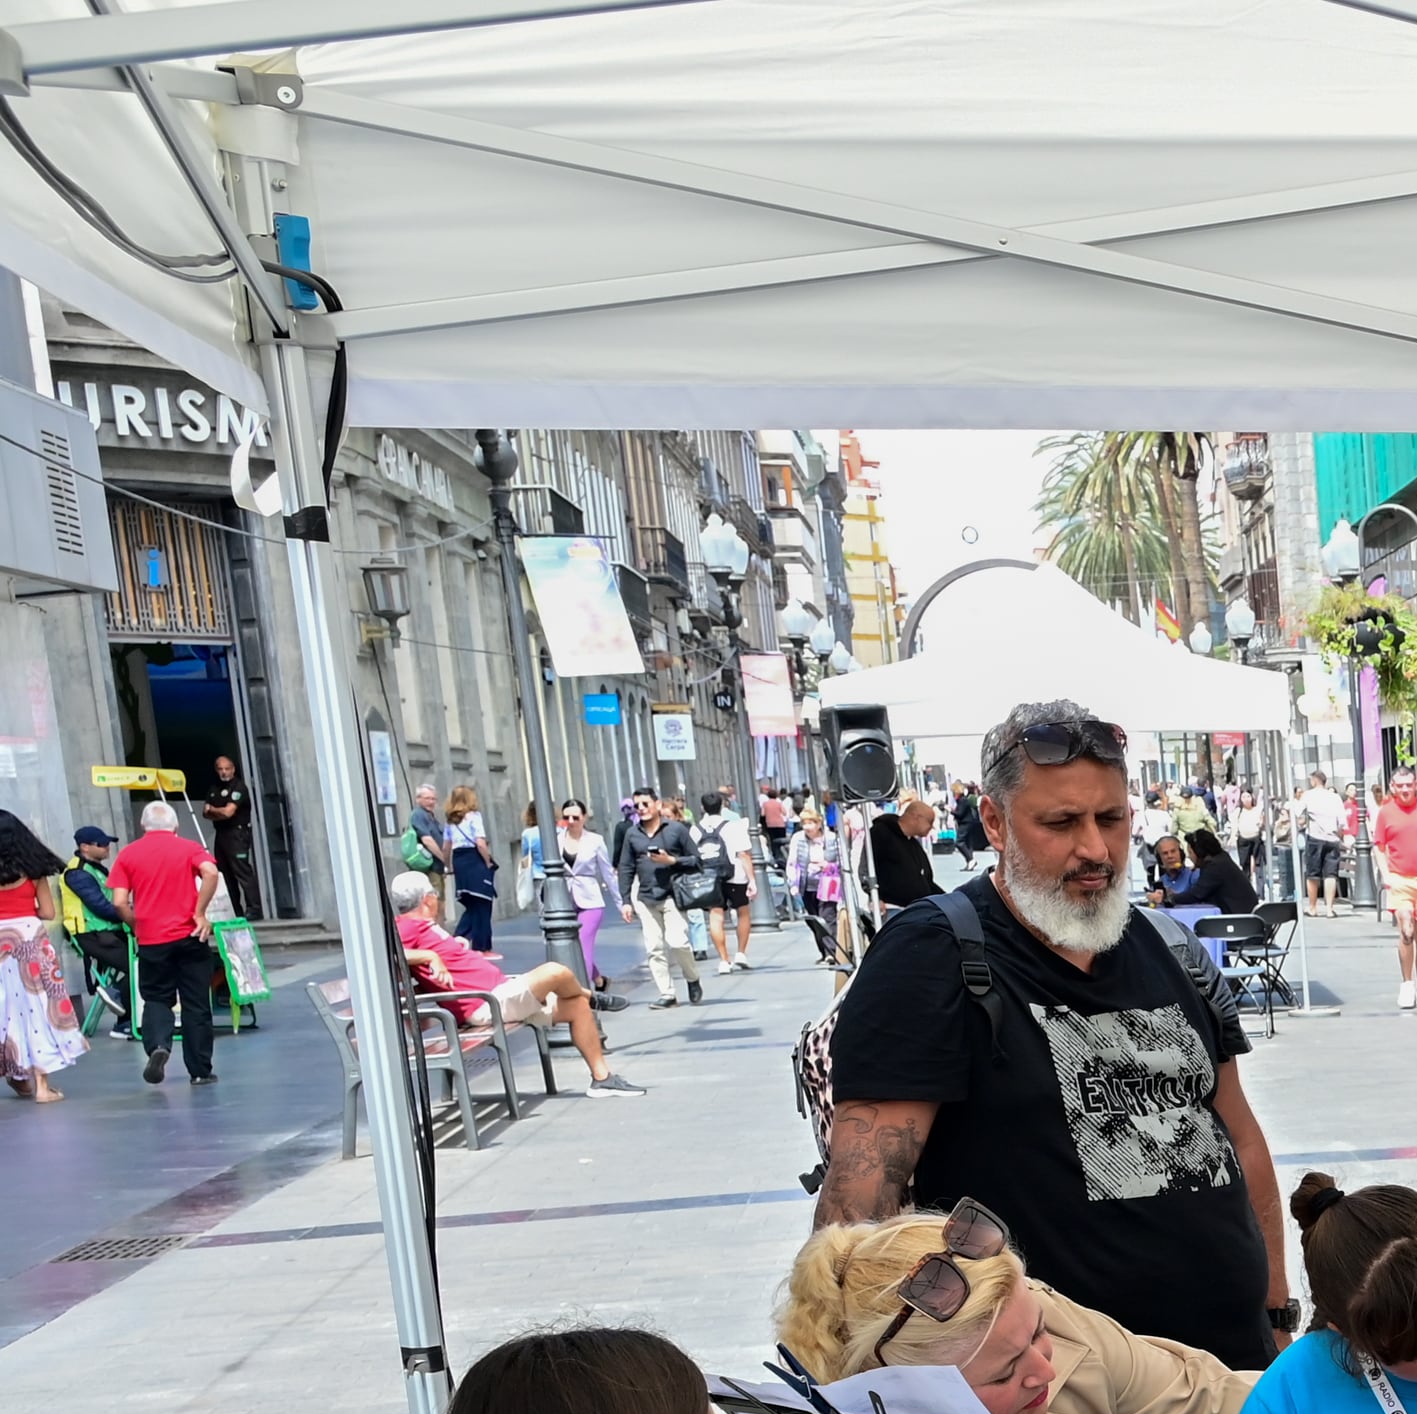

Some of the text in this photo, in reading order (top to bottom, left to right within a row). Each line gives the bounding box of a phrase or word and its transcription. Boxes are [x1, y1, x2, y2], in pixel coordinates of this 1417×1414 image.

[57, 380, 270, 447] URISM
[716, 695, 732, 708] IN
[1377, 1381, 1396, 1409] RADIO
